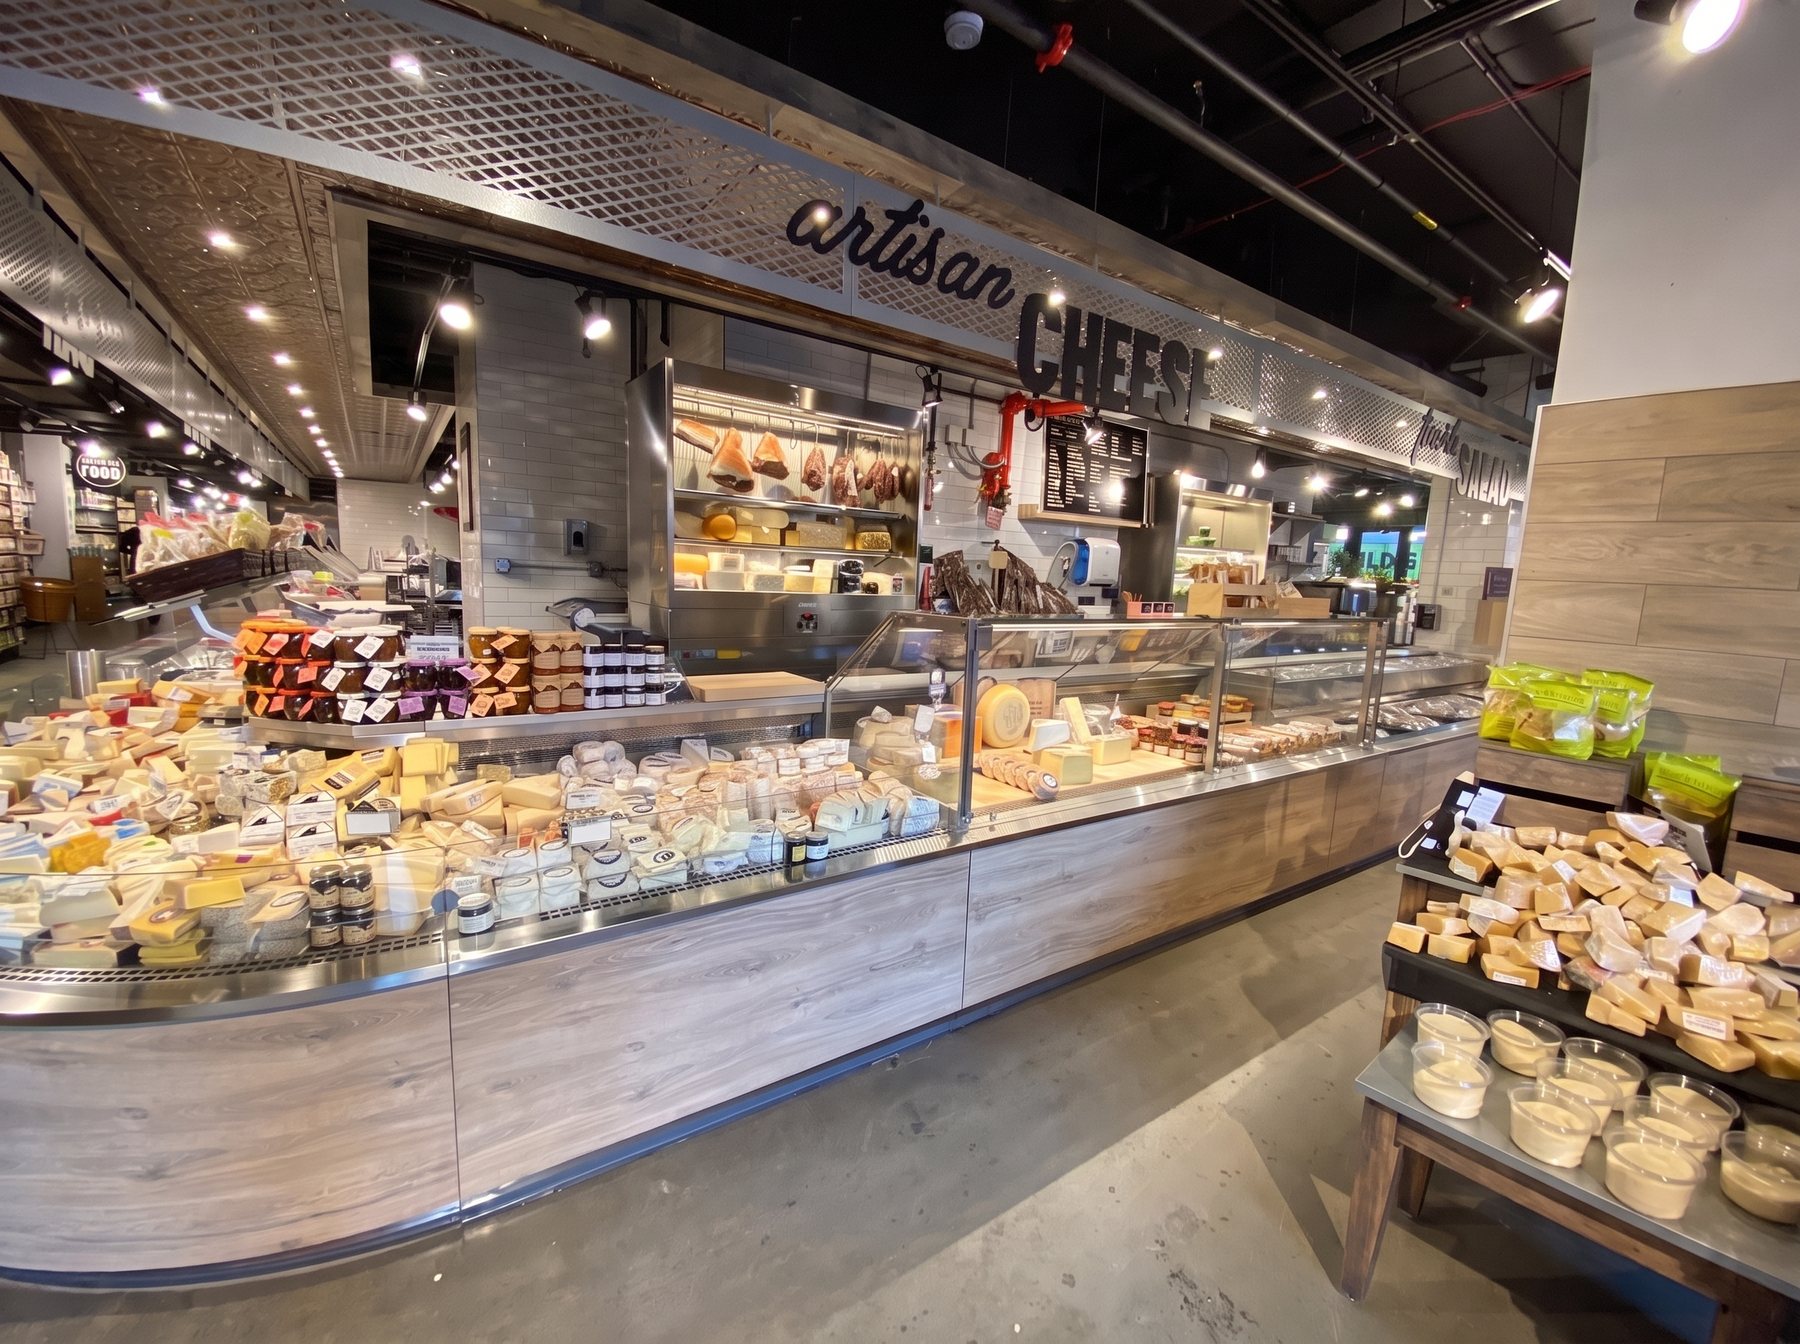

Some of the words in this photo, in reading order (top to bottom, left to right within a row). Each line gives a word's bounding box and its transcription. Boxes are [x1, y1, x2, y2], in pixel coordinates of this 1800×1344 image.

[786, 199, 1015, 309] artisan
[1017, 293, 1215, 431] CHEESE
[81, 464, 121, 480] FOOD
[1456, 443, 1509, 507] SALAD
